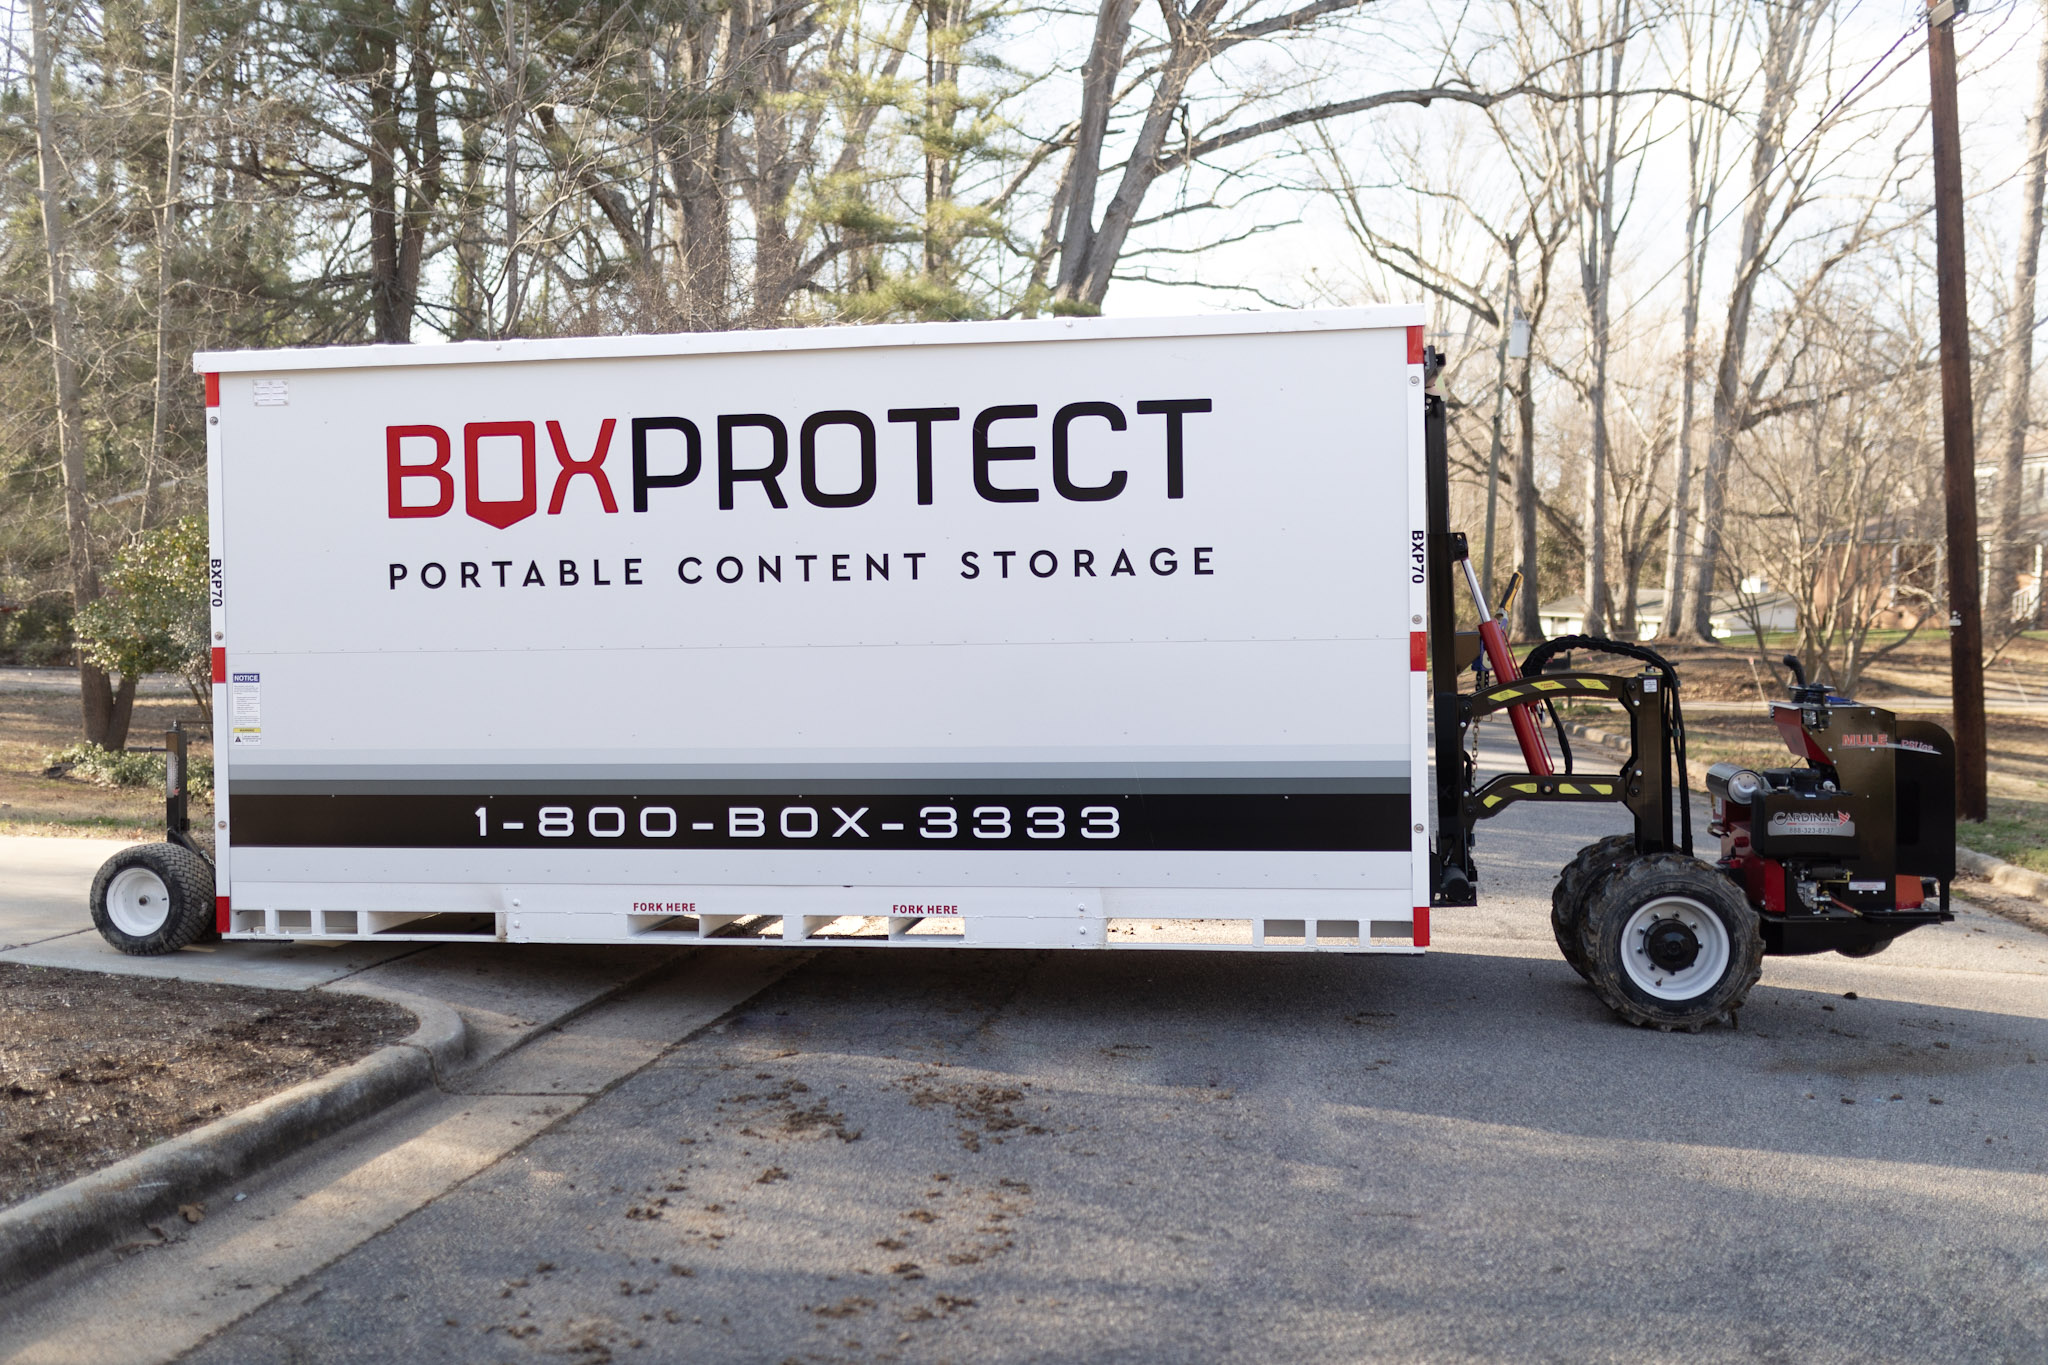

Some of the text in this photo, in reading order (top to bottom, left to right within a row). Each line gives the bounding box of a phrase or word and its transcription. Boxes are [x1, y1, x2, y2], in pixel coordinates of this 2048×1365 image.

[386, 398, 1213, 530] BOXPROTECT
[389, 546, 1214, 590] PORTABLE CONTENT STORAGE
[1411, 530, 1425, 584] BXP70
[211, 559, 223, 607] BXP70
[234, 674, 258, 682] NOTICE
[1842, 733, 1888, 747] MULE
[474, 806, 1120, 839] 1-800-BOX-3333
[633, 902, 696, 912] FORK HERE
[892, 904, 958, 915] FORK HERE
